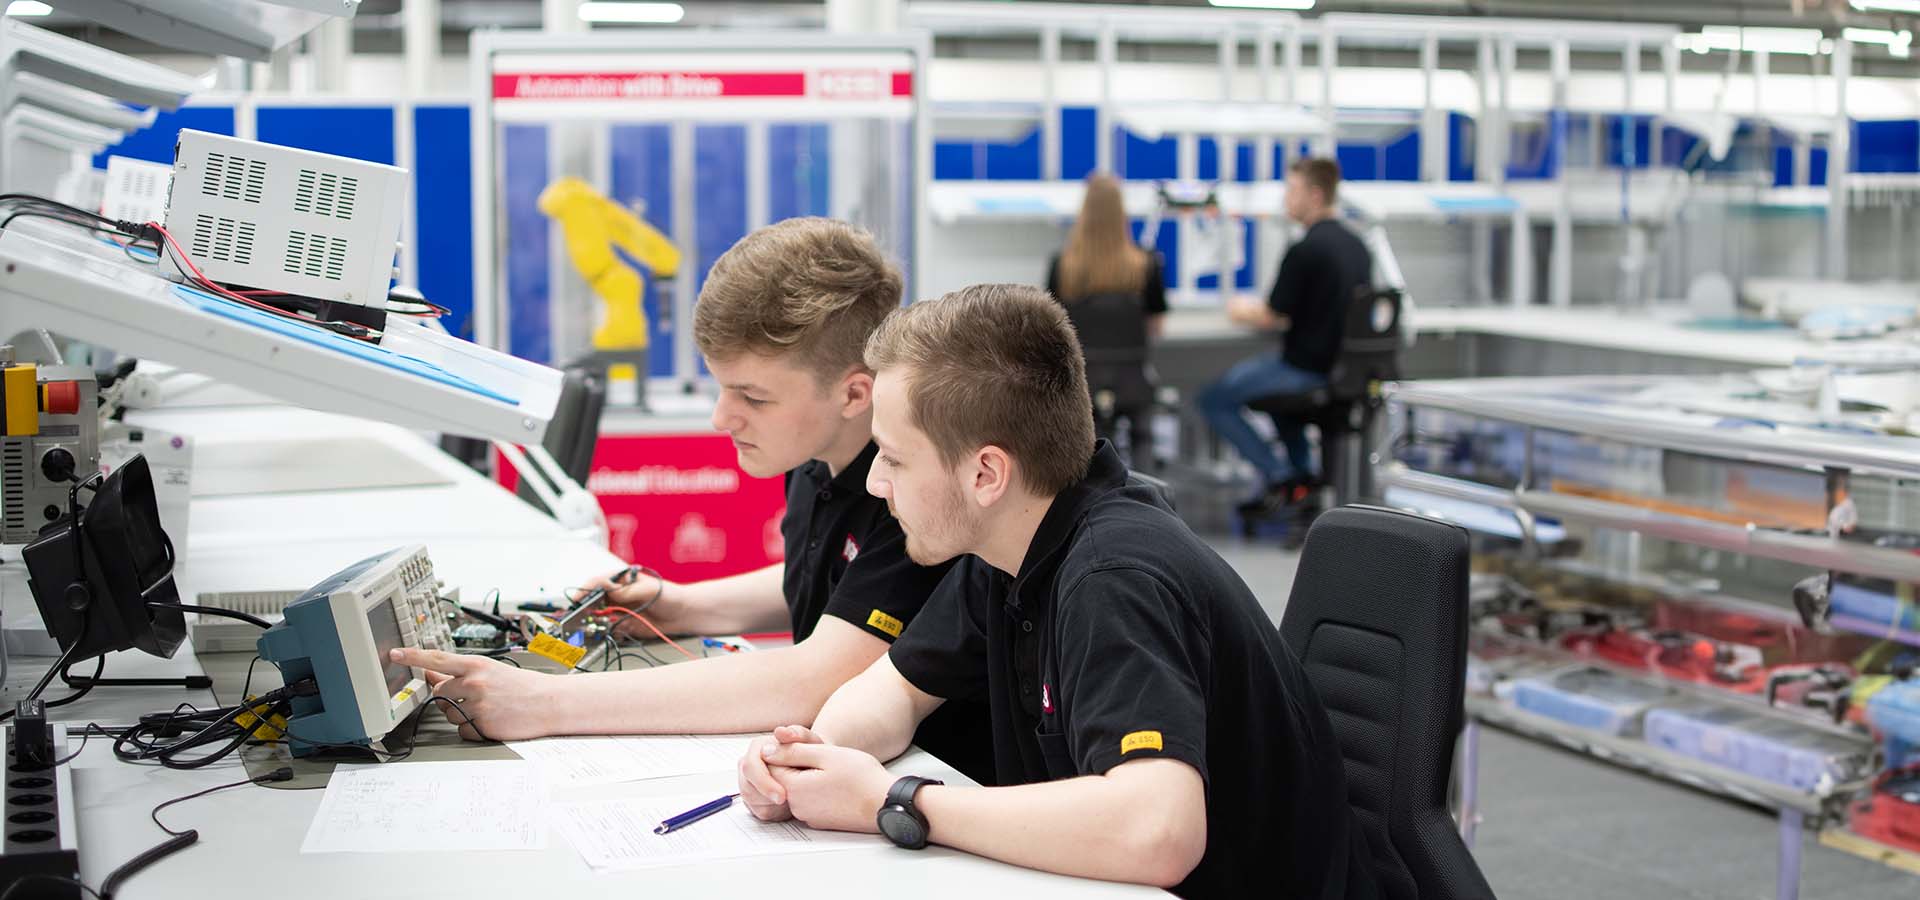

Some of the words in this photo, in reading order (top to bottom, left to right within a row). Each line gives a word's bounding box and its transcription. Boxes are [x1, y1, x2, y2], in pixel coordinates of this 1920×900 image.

[515, 74, 617, 97] Automation
[620, 73, 665, 97] with
[668, 73, 724, 97] Drive
[649, 465, 740, 494] Education
